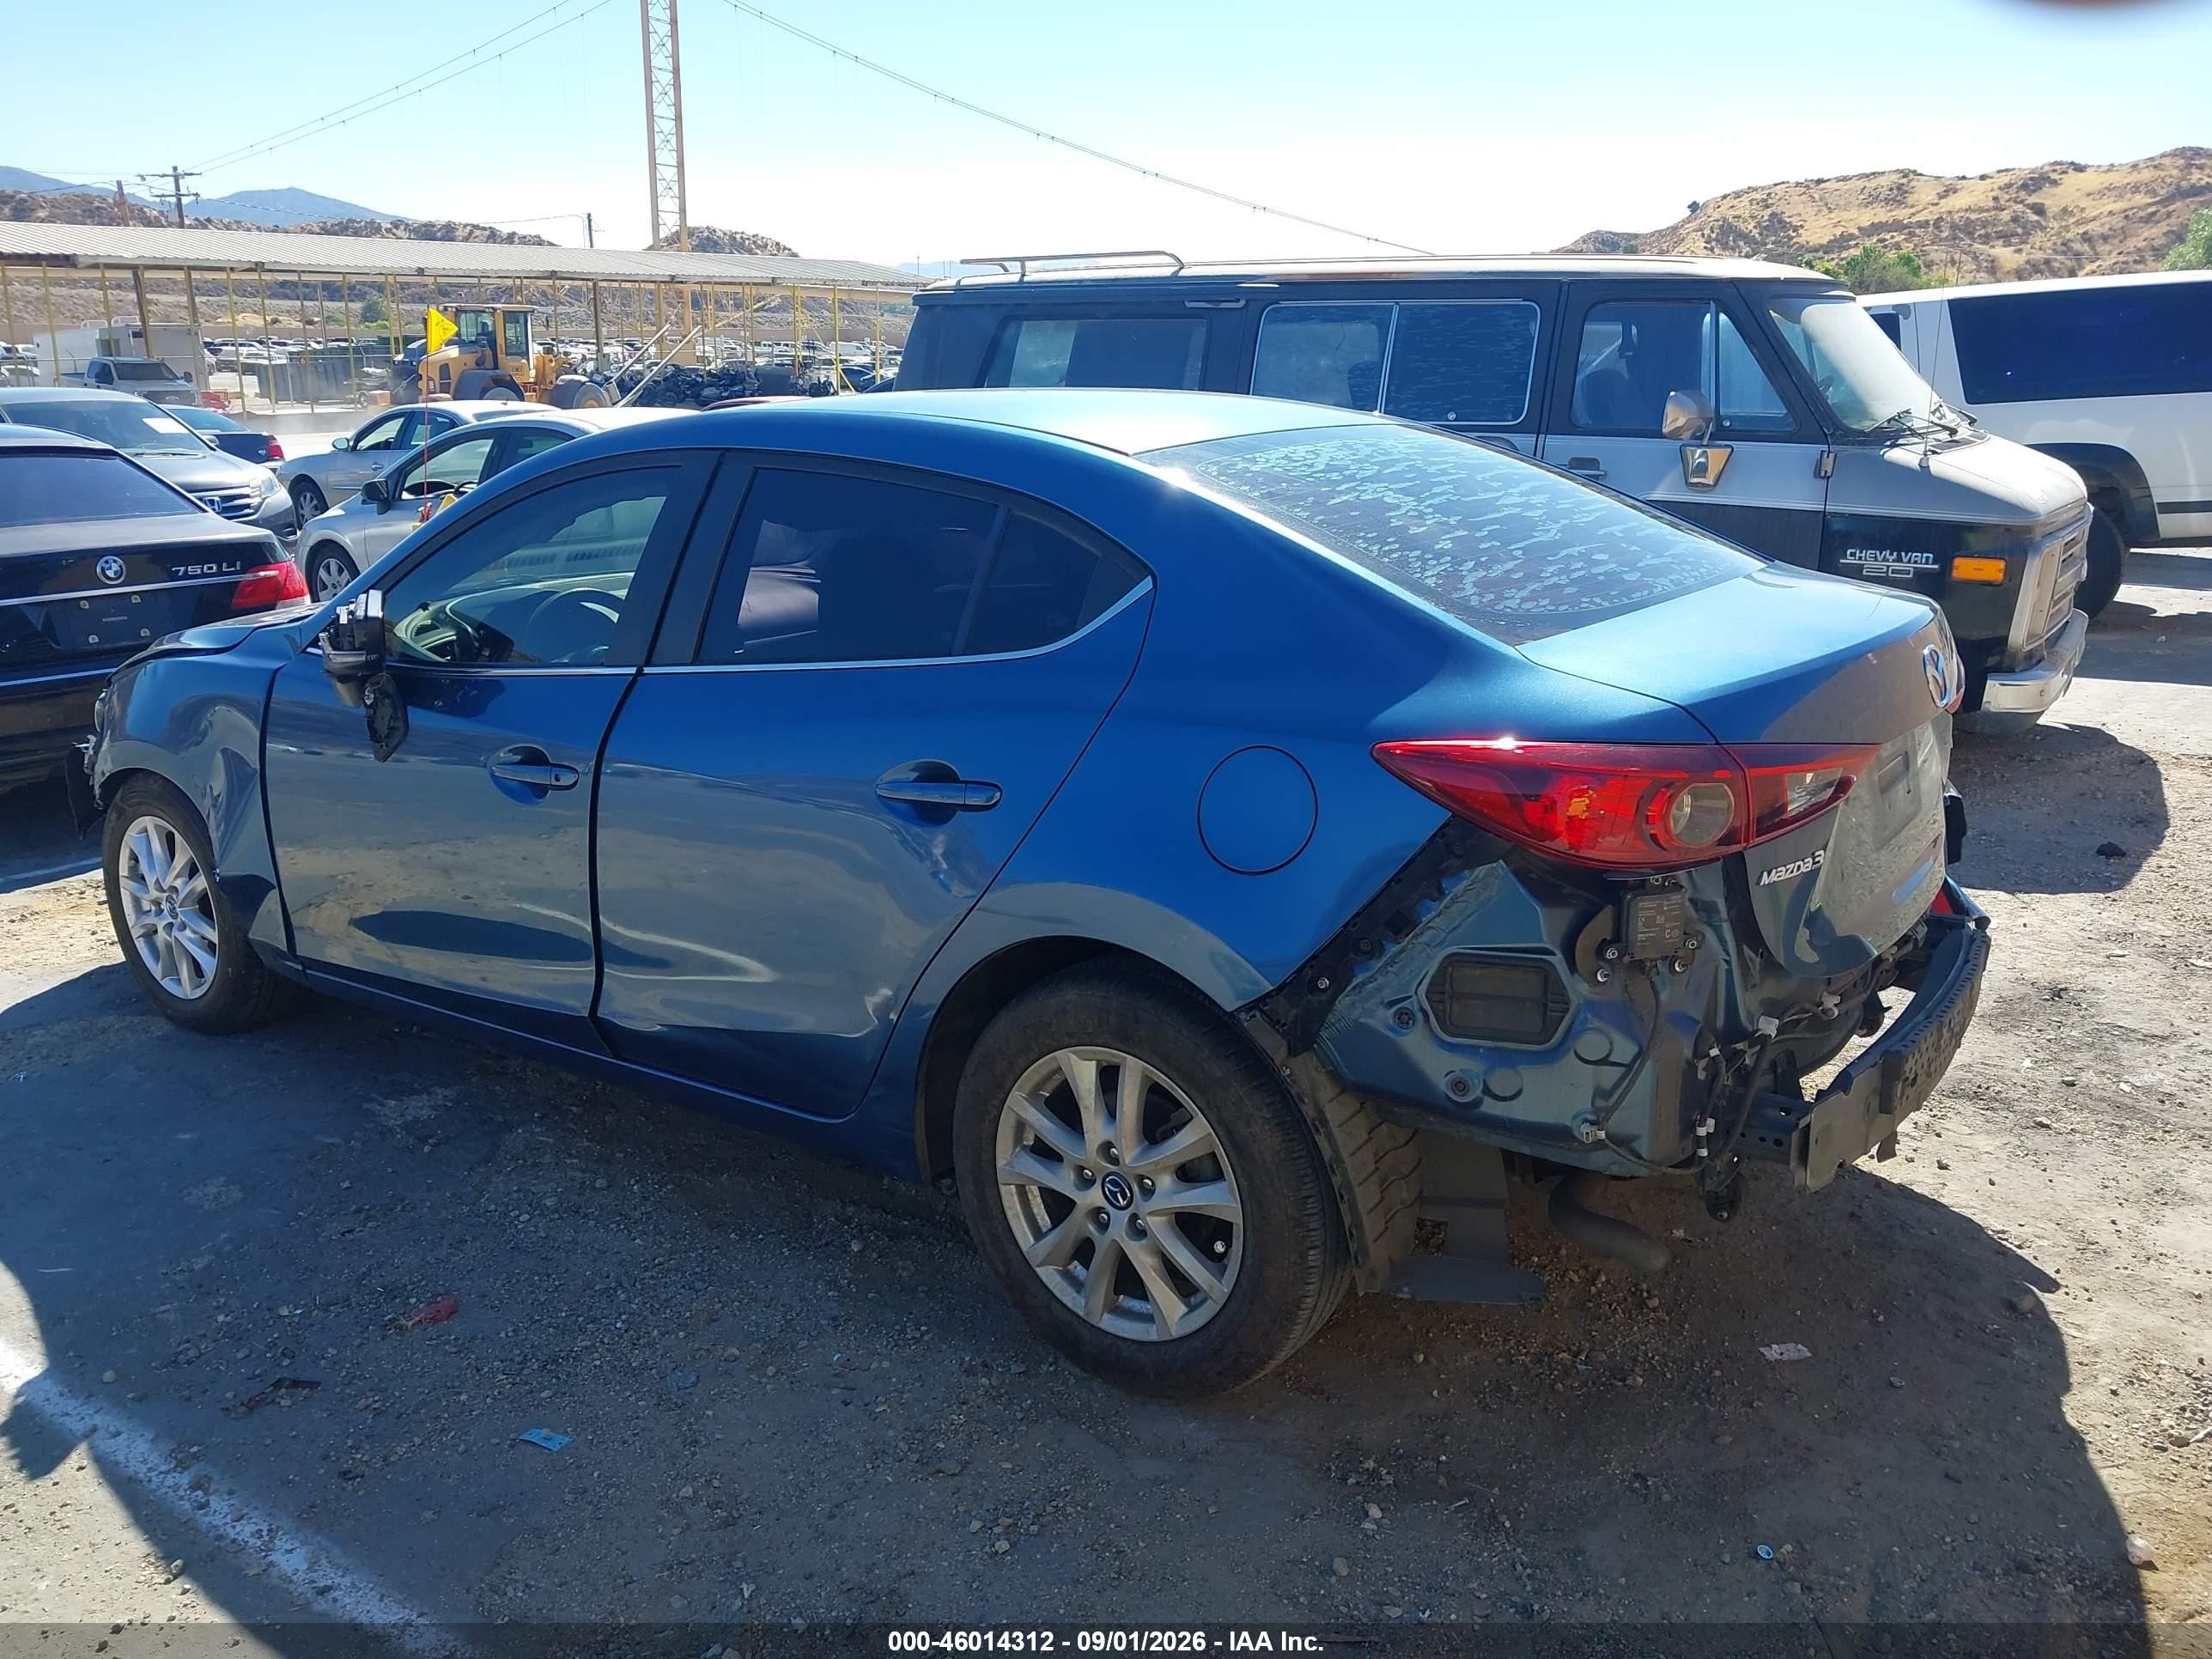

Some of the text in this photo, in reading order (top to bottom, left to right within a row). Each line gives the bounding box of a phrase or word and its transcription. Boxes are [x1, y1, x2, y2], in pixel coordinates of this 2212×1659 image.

[1846, 549, 1934, 564] CHEVY VAN
[172, 563, 217, 576] 750
[1863, 564, 1914, 578] 20
